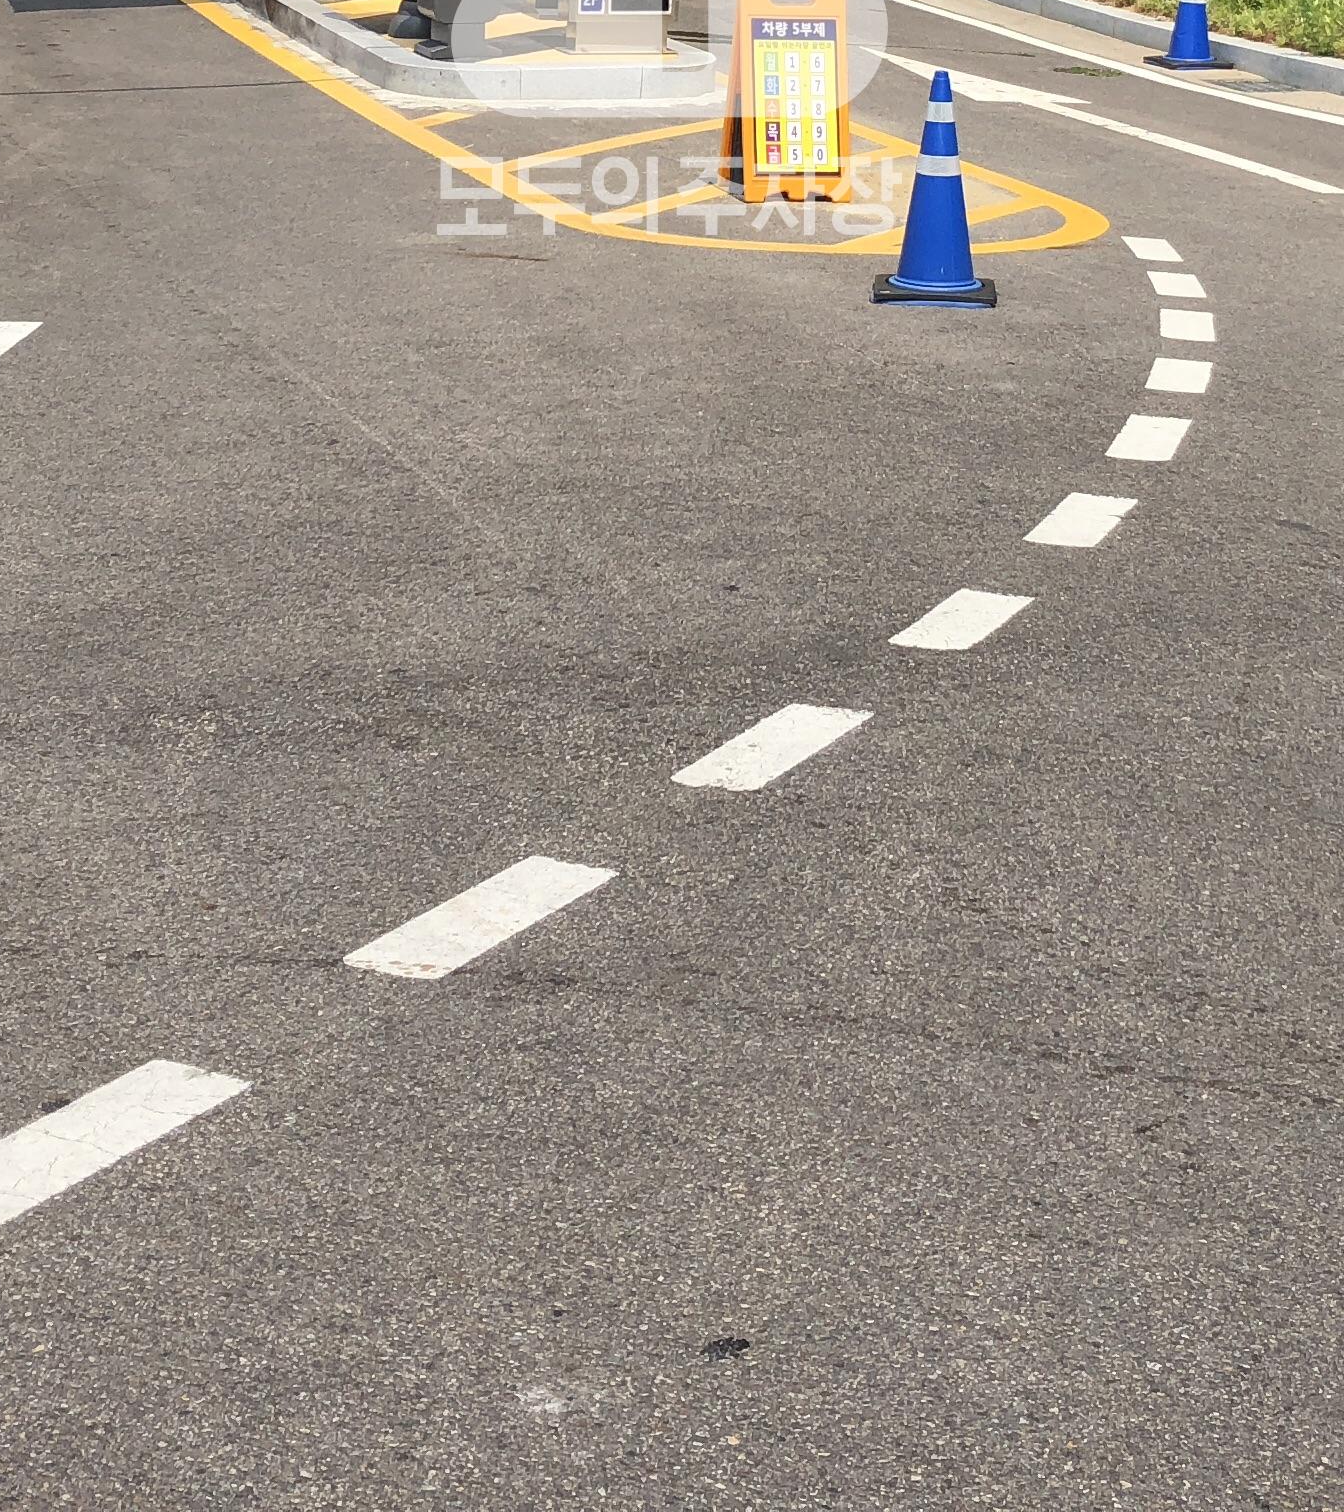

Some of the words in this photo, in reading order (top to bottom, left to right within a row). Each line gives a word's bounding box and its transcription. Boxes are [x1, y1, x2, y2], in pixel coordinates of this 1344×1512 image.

[761, 21, 789, 37] 차량
[792, 22, 826, 38] 5부제
[765, 52, 778, 72] 월
[789, 56, 796, 69] 1
[814, 56, 821, 69] 6
[766, 76, 778, 95] 화
[790, 79, 796, 92] 2
[815, 79, 821, 92] 7
[766, 101, 779, 118] 수
[790, 103, 797, 116] 3
[815, 103, 822, 116] 8
[768, 123, 778, 141] 목
[791, 126, 798, 138] 4
[816, 126, 822, 138] 9
[768, 146, 780, 164] 금
[792, 148, 798, 161] 5
[817, 148, 823, 161] 0
